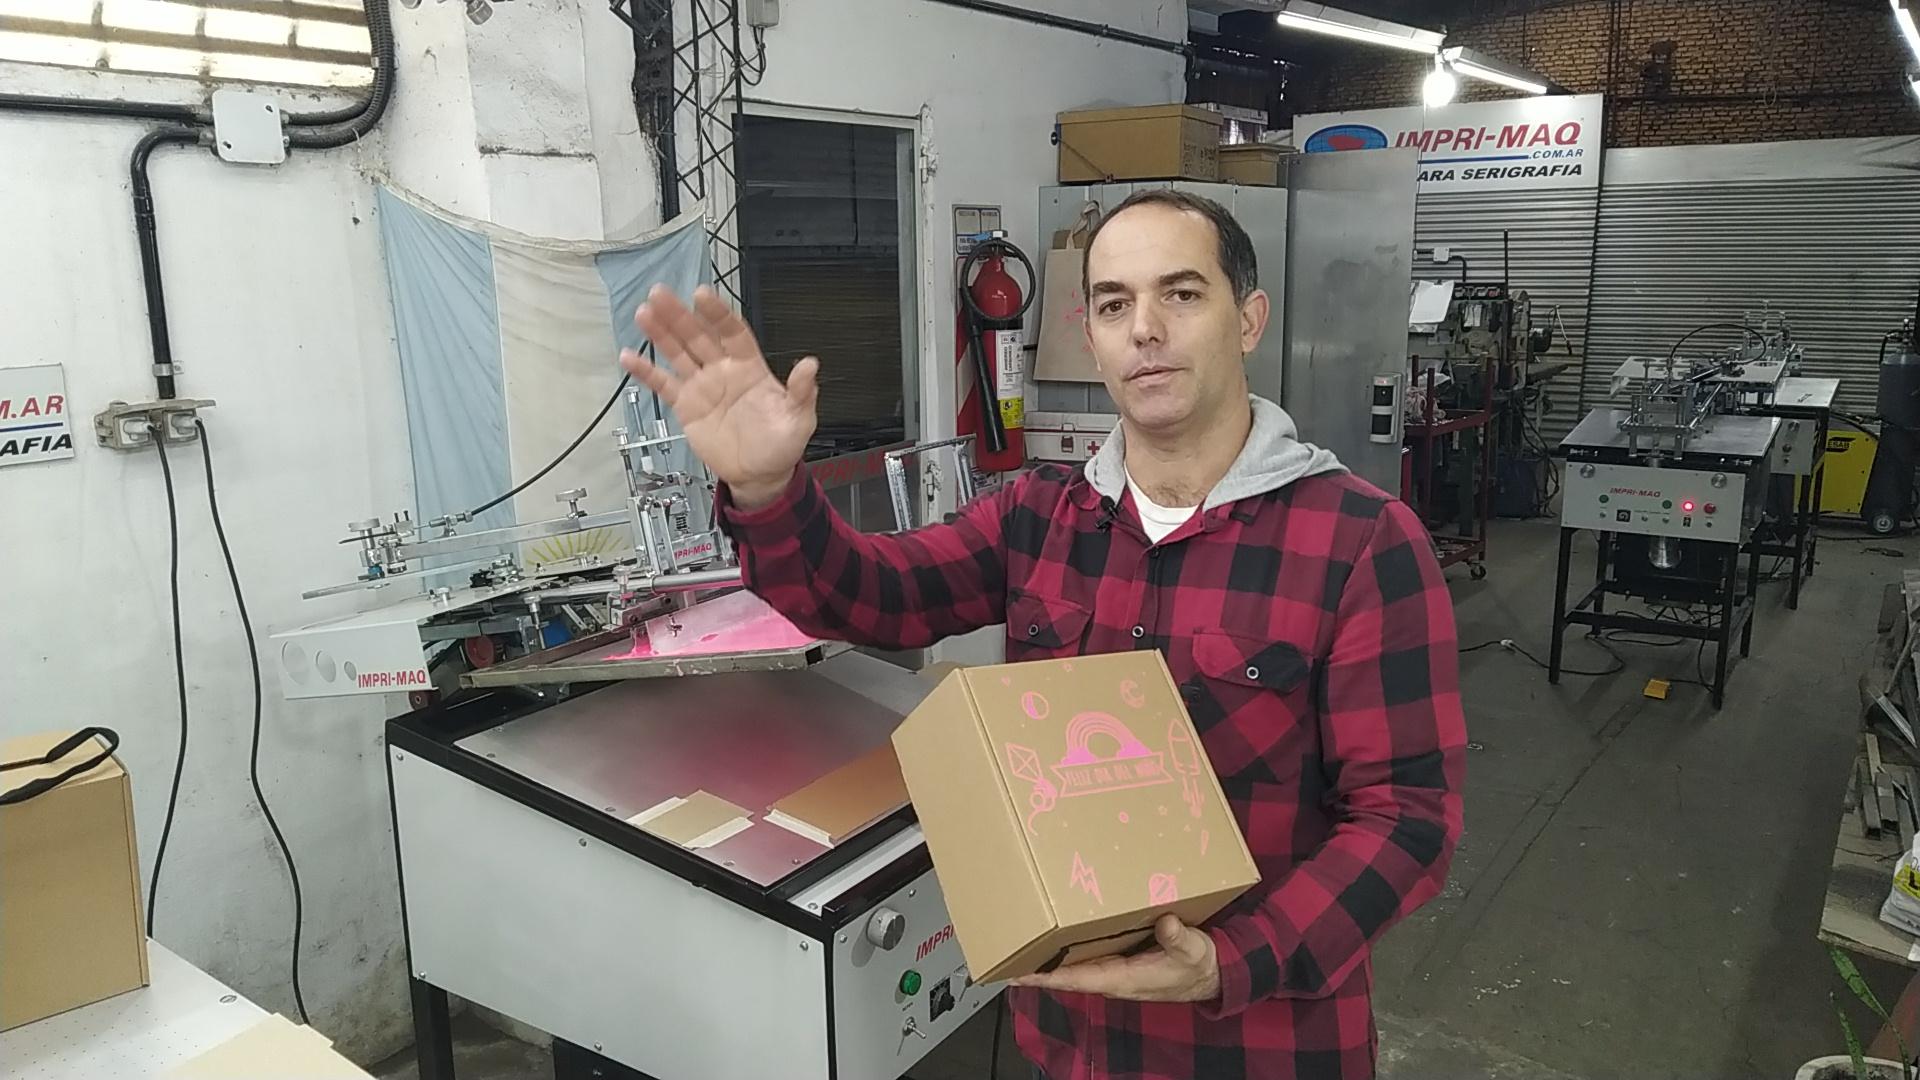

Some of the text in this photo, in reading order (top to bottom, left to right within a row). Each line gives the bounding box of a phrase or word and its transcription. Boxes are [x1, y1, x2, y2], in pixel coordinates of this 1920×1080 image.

[1395, 121, 1582, 152] IMPRI-MAQ
[1528, 148, 1584, 160] .COM.AR
[1461, 163, 1583, 180] SERIGRAFIA
[0, 433, 73, 456] AFIA
[1610, 487, 1661, 498] IMPRI-MAQ
[358, 669, 426, 688] IMPRI-MAQ
